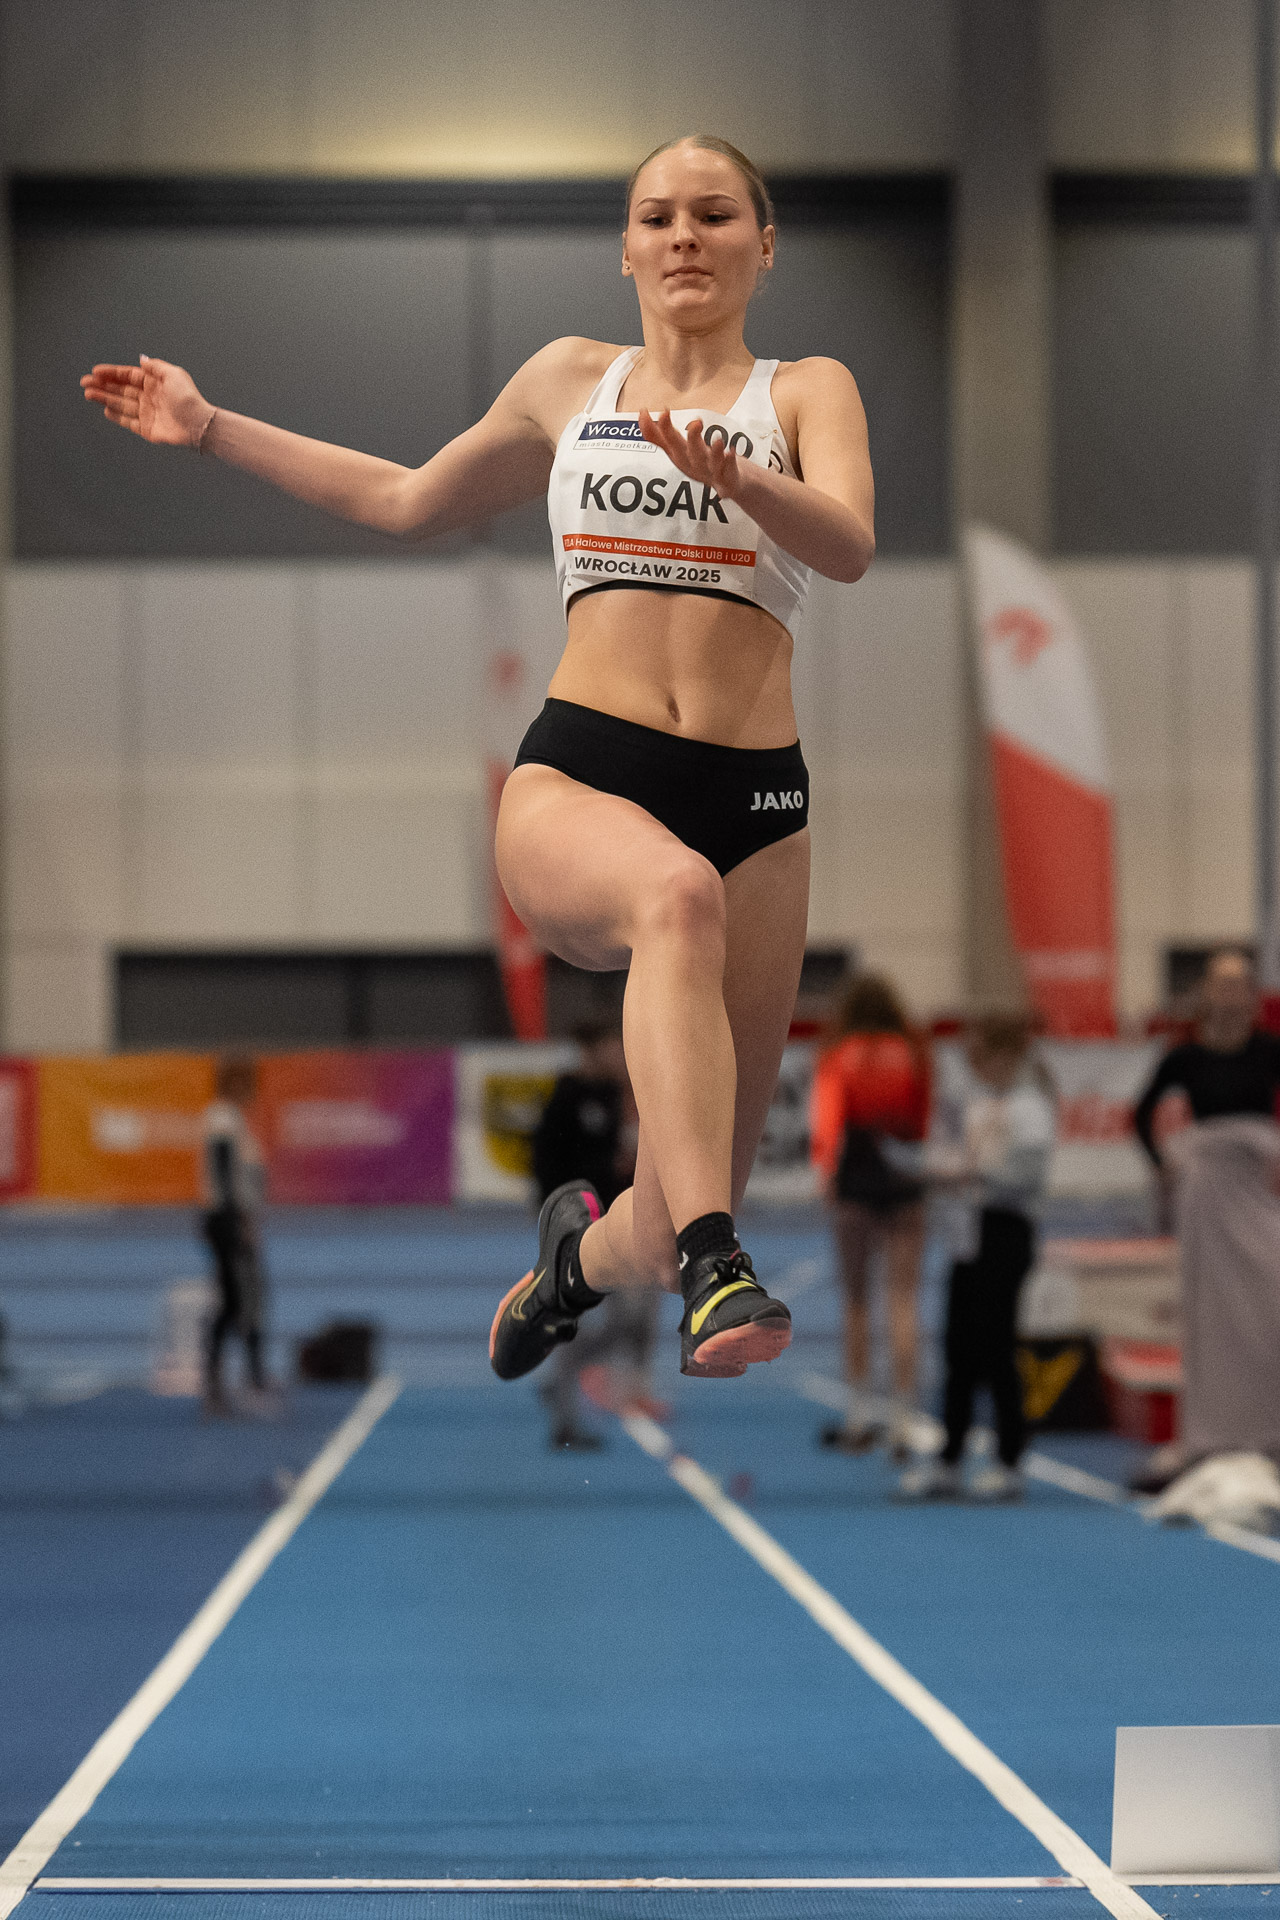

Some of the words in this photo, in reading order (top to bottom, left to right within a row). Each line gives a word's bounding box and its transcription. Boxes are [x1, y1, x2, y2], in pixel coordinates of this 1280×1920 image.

[588, 423, 643, 437] Wrocła
[614, 442, 653, 450] spotkań
[575, 538, 612, 550] Halowe
[614, 541, 673, 556] Mistrzostwa
[675, 547, 704, 559] Polski
[705, 551, 723, 560] U18
[731, 553, 751, 563] U20
[575, 556, 673, 579] WROCŁAW
[676, 566, 722, 583] 2025
[750, 790, 804, 811] JAKO
